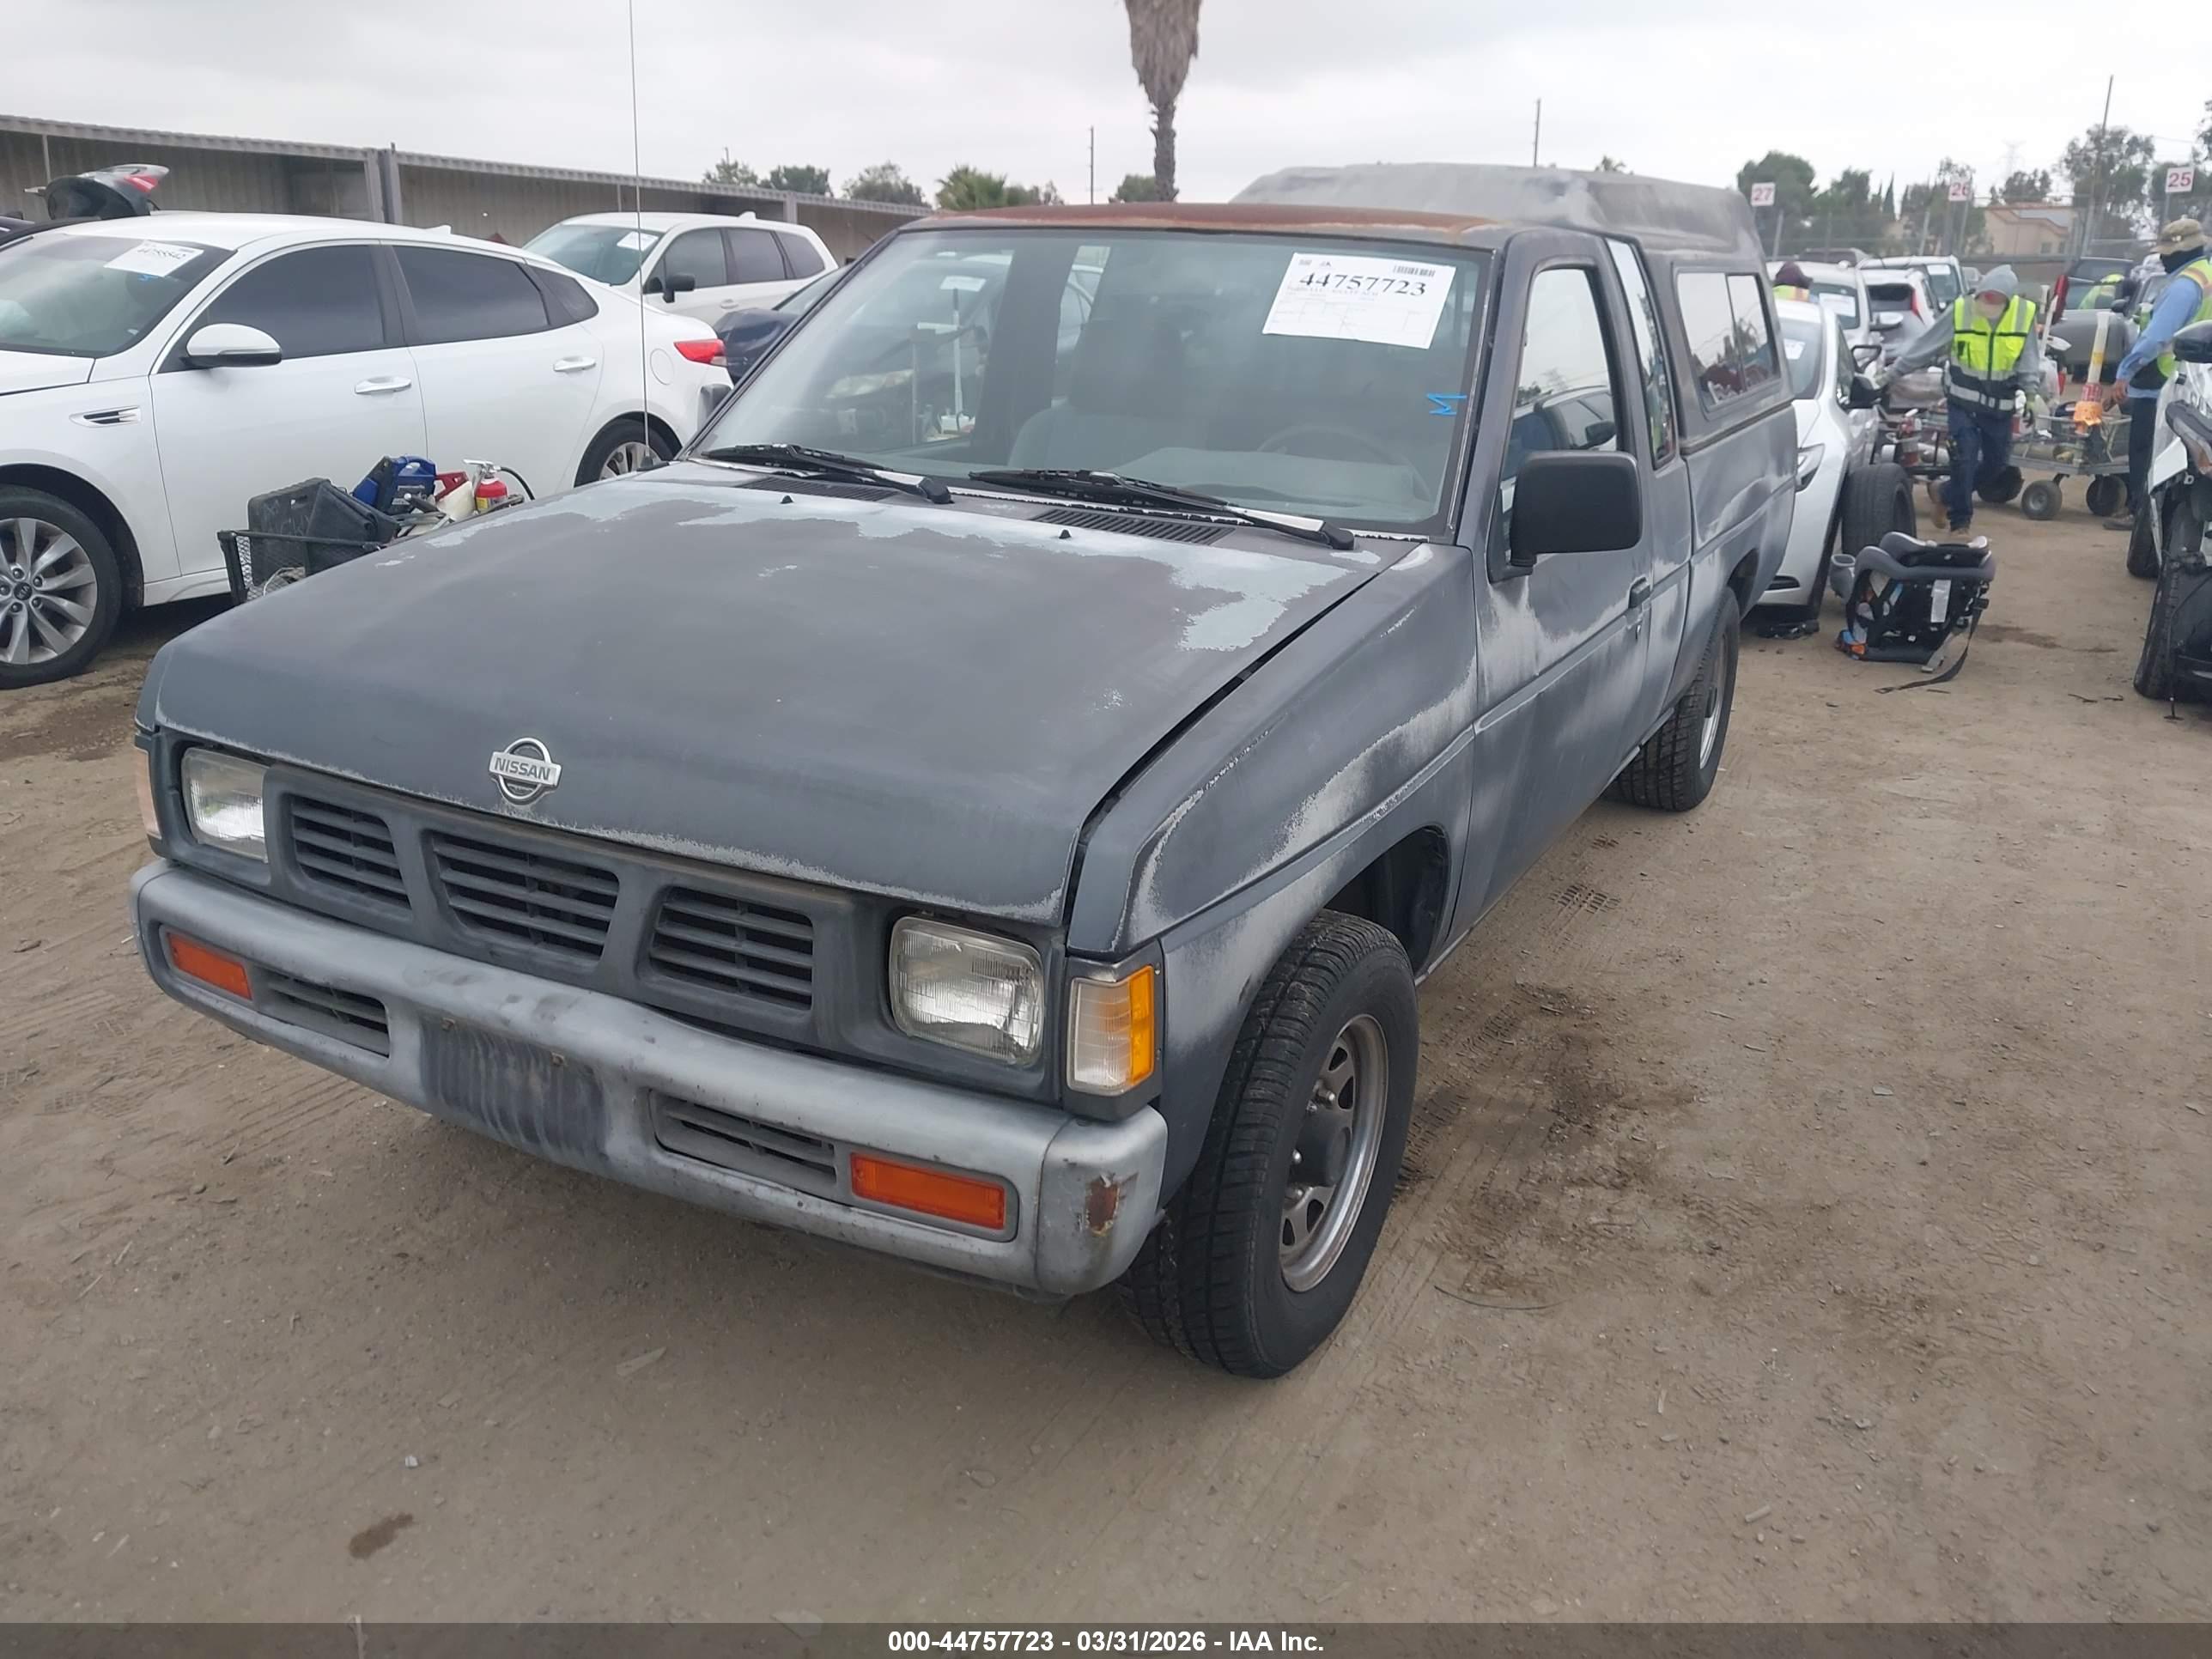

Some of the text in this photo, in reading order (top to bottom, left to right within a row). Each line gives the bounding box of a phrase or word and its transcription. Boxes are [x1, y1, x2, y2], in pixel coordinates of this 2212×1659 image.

[2168, 172, 2192, 187] 25
[1753, 187, 1772, 202] 27
[1299, 272, 1427, 297] 44757723
[494, 757, 550, 781] NISSAN
